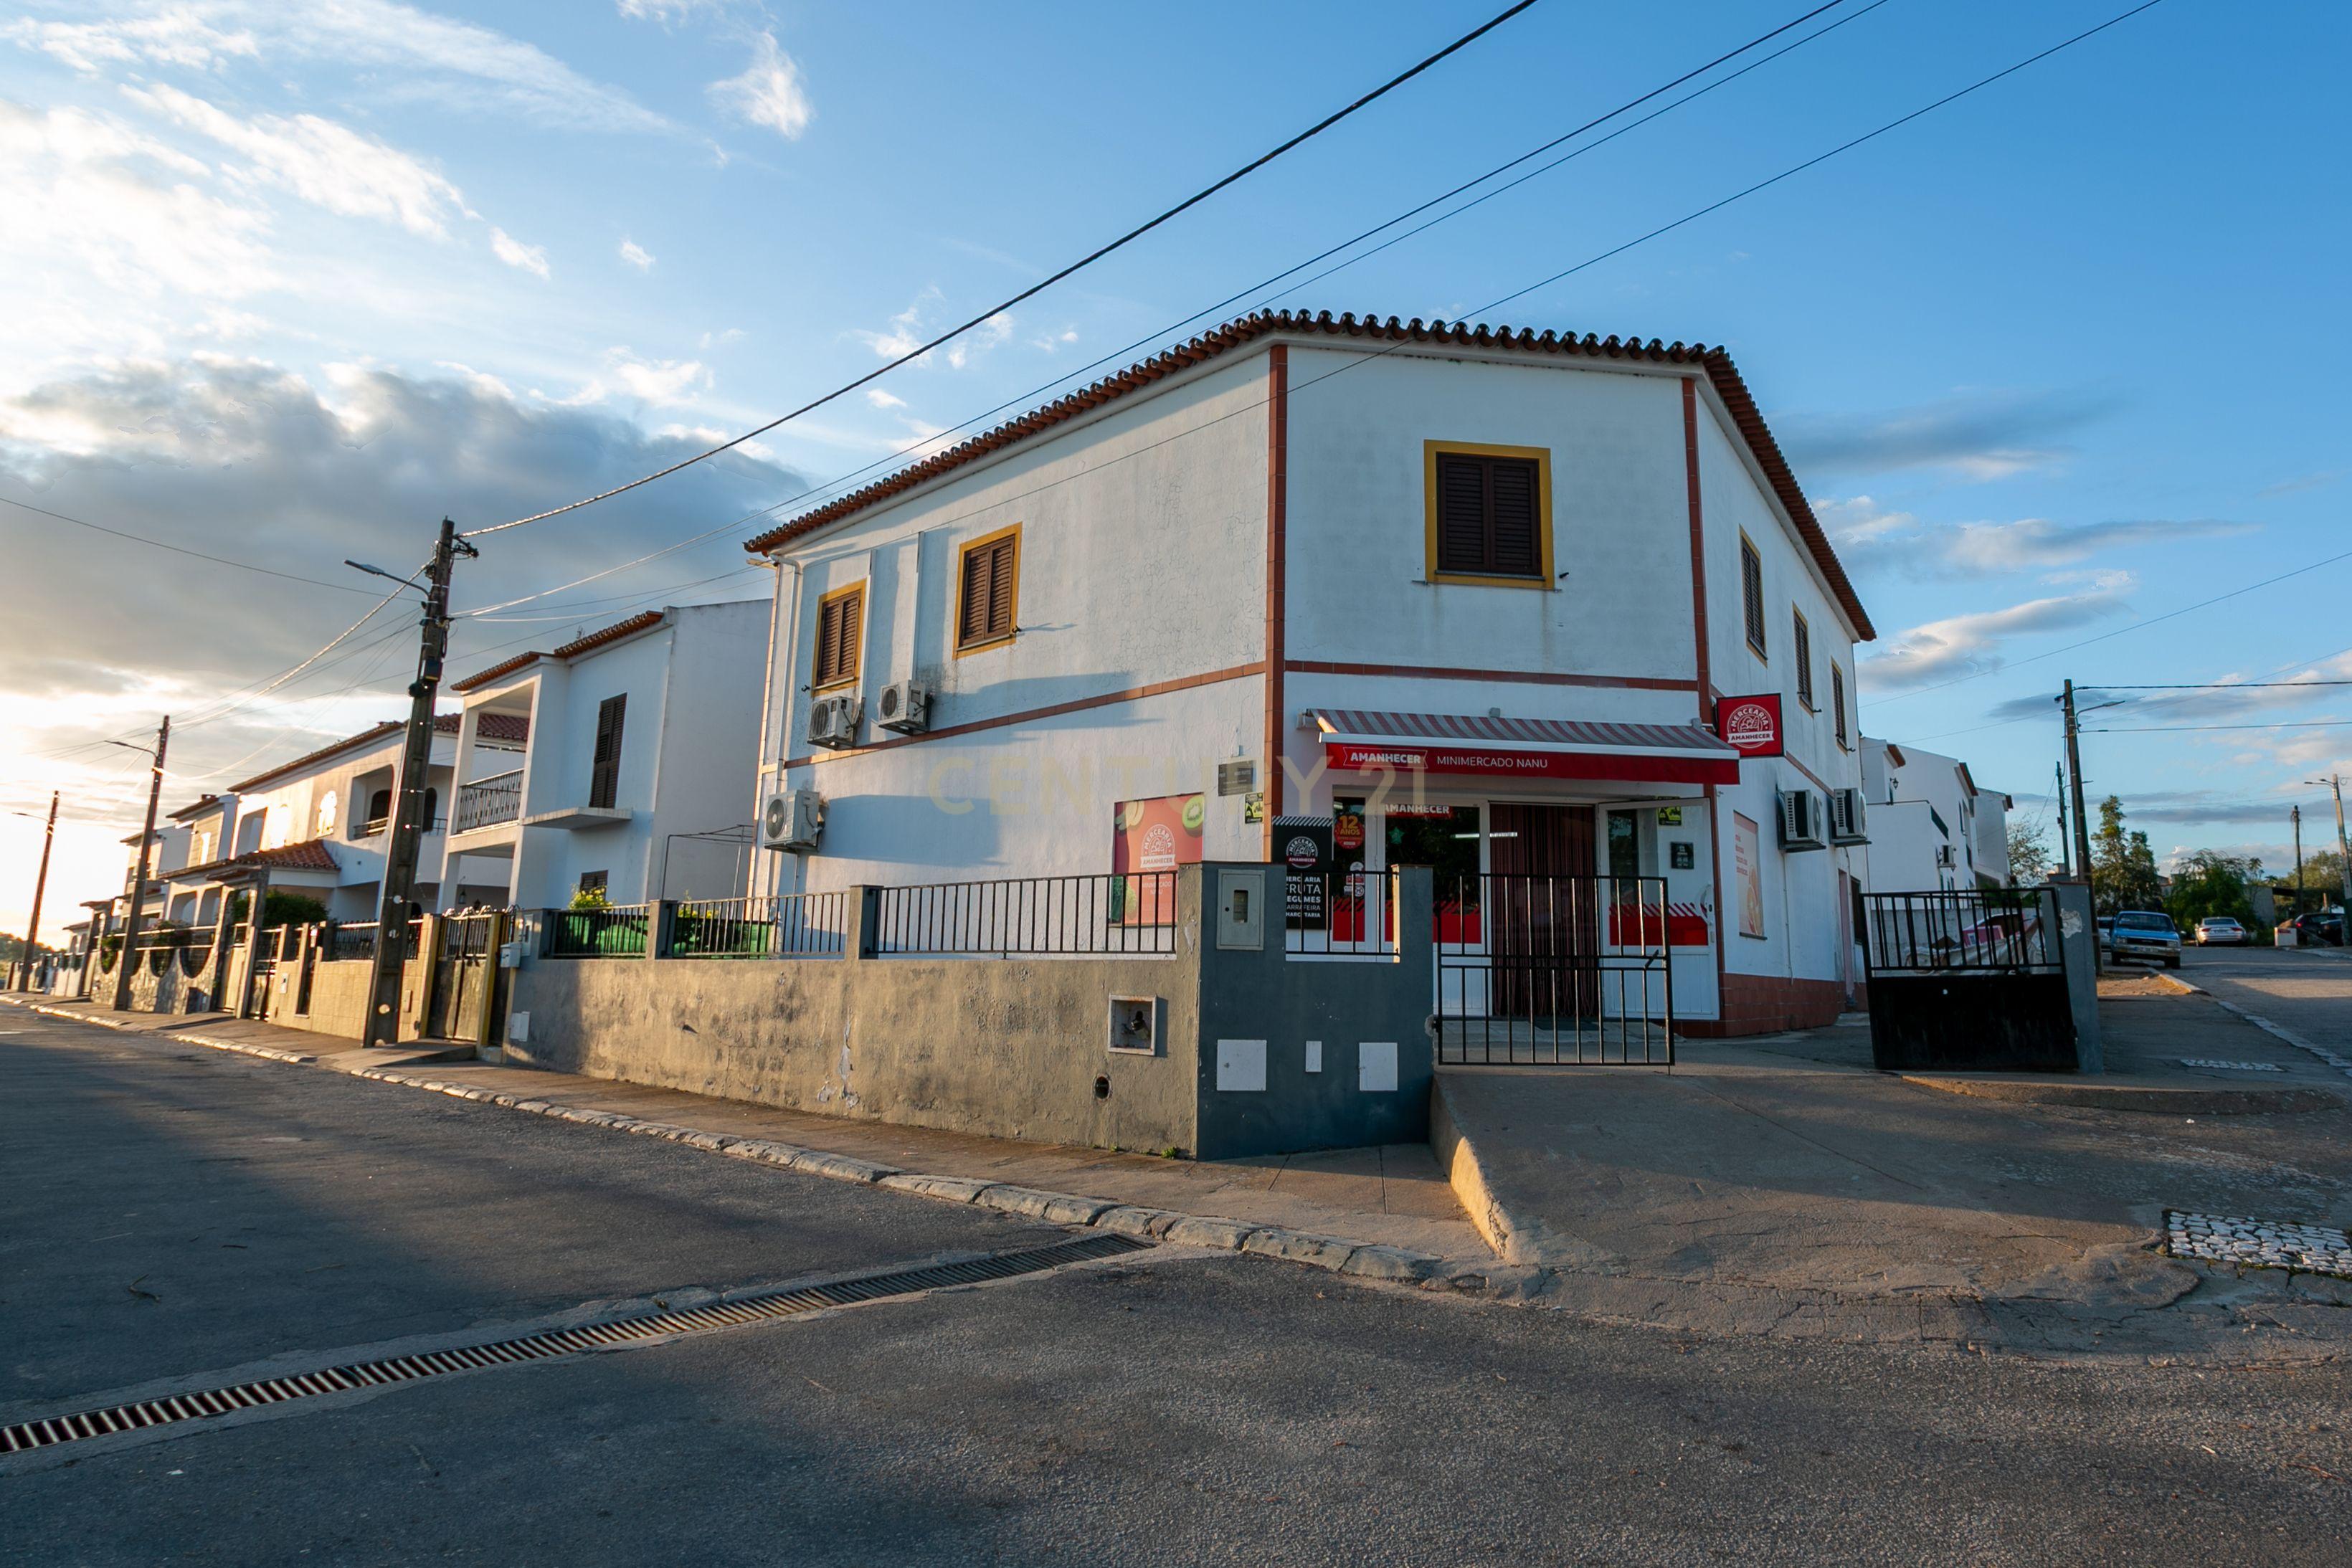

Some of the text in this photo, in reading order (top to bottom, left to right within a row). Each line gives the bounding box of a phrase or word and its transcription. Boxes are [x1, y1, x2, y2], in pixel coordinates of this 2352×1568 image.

[1730, 708, 1769, 728] MERCEARIA
[1350, 751, 1421, 764] AMANHECER
[1436, 755, 1548, 769] MINIMERCADO NANU
[1383, 804, 1450, 814] AMANHECER
[1339, 814, 1359, 829] 12
[1144, 827, 1172, 850] MERCEARIA
[1289, 839, 1315, 854] MERCEARIA
[1142, 856, 1173, 865] AMANHECER
